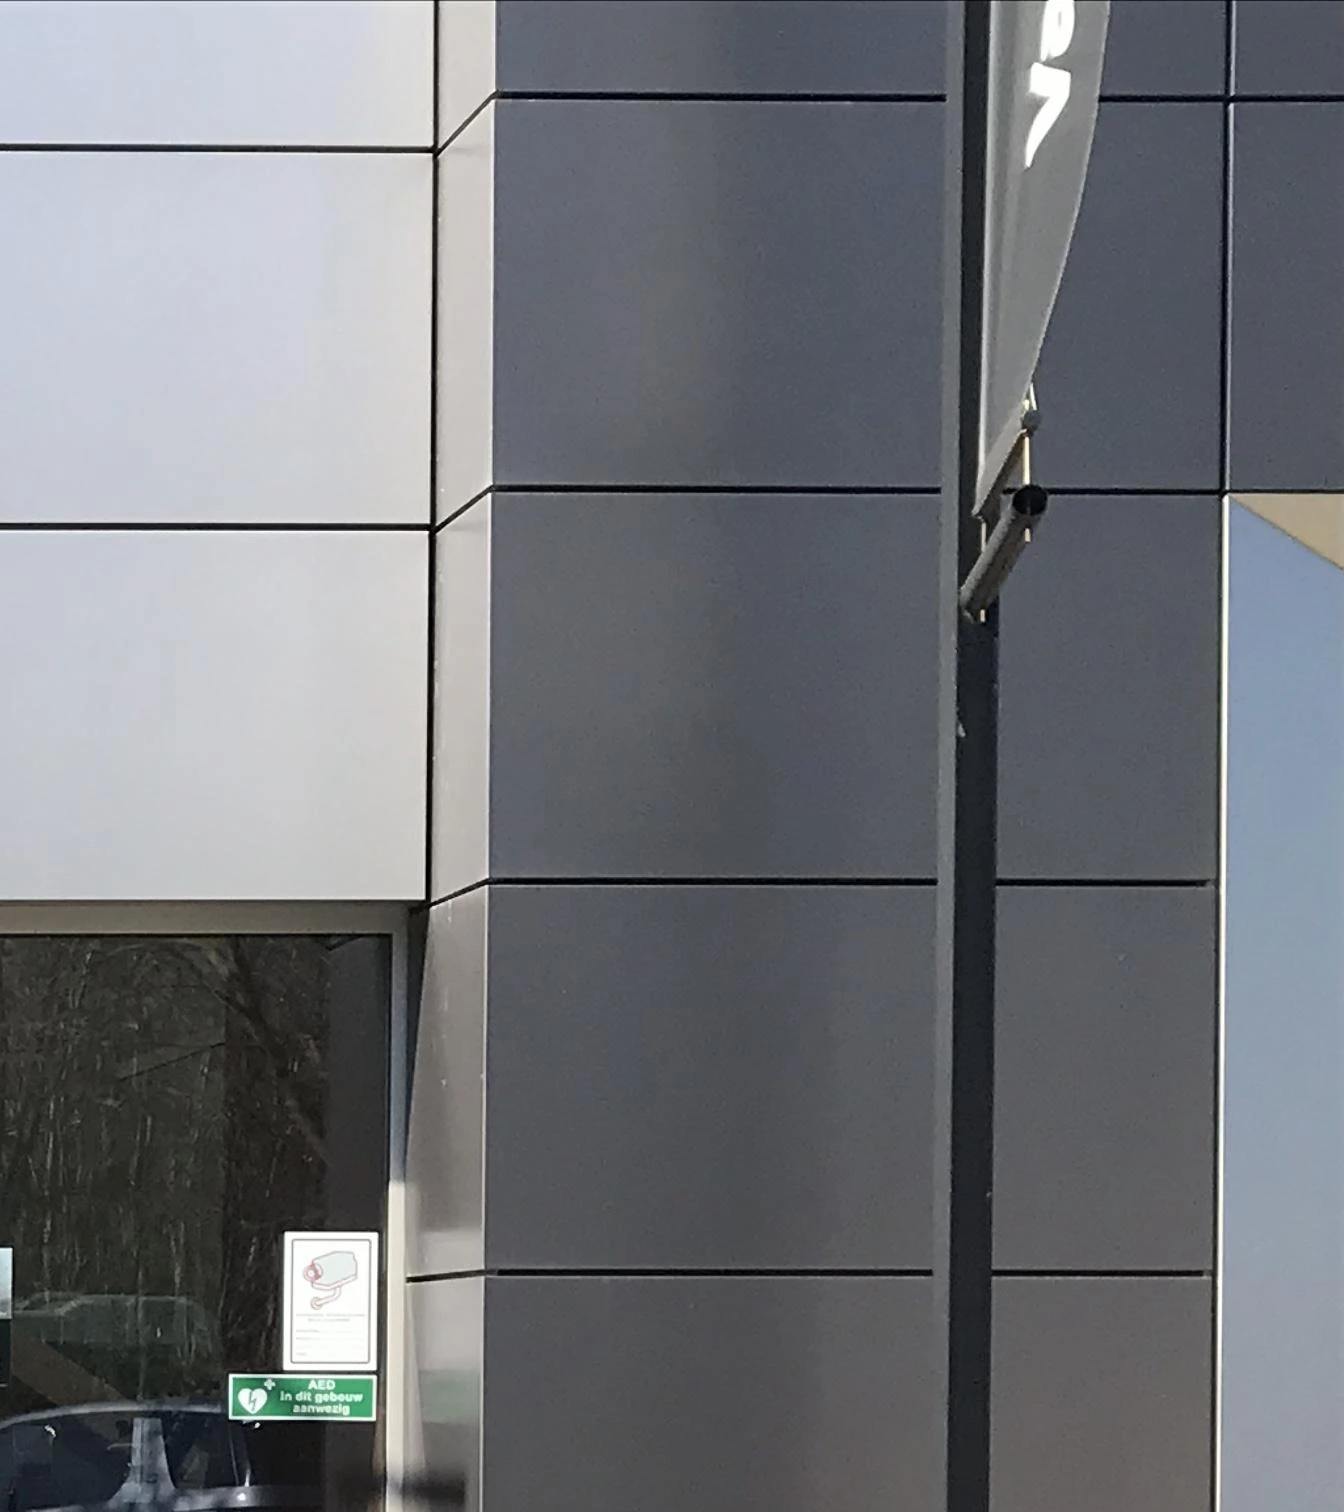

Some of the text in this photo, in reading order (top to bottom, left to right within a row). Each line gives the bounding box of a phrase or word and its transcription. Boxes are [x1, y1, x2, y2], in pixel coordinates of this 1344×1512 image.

[308, 1379, 336, 1390] AED
[295, 1391, 312, 1402] dit
[314, 1391, 364, 1404] gebouw
[292, 1404, 351, 1416] aanwezig
